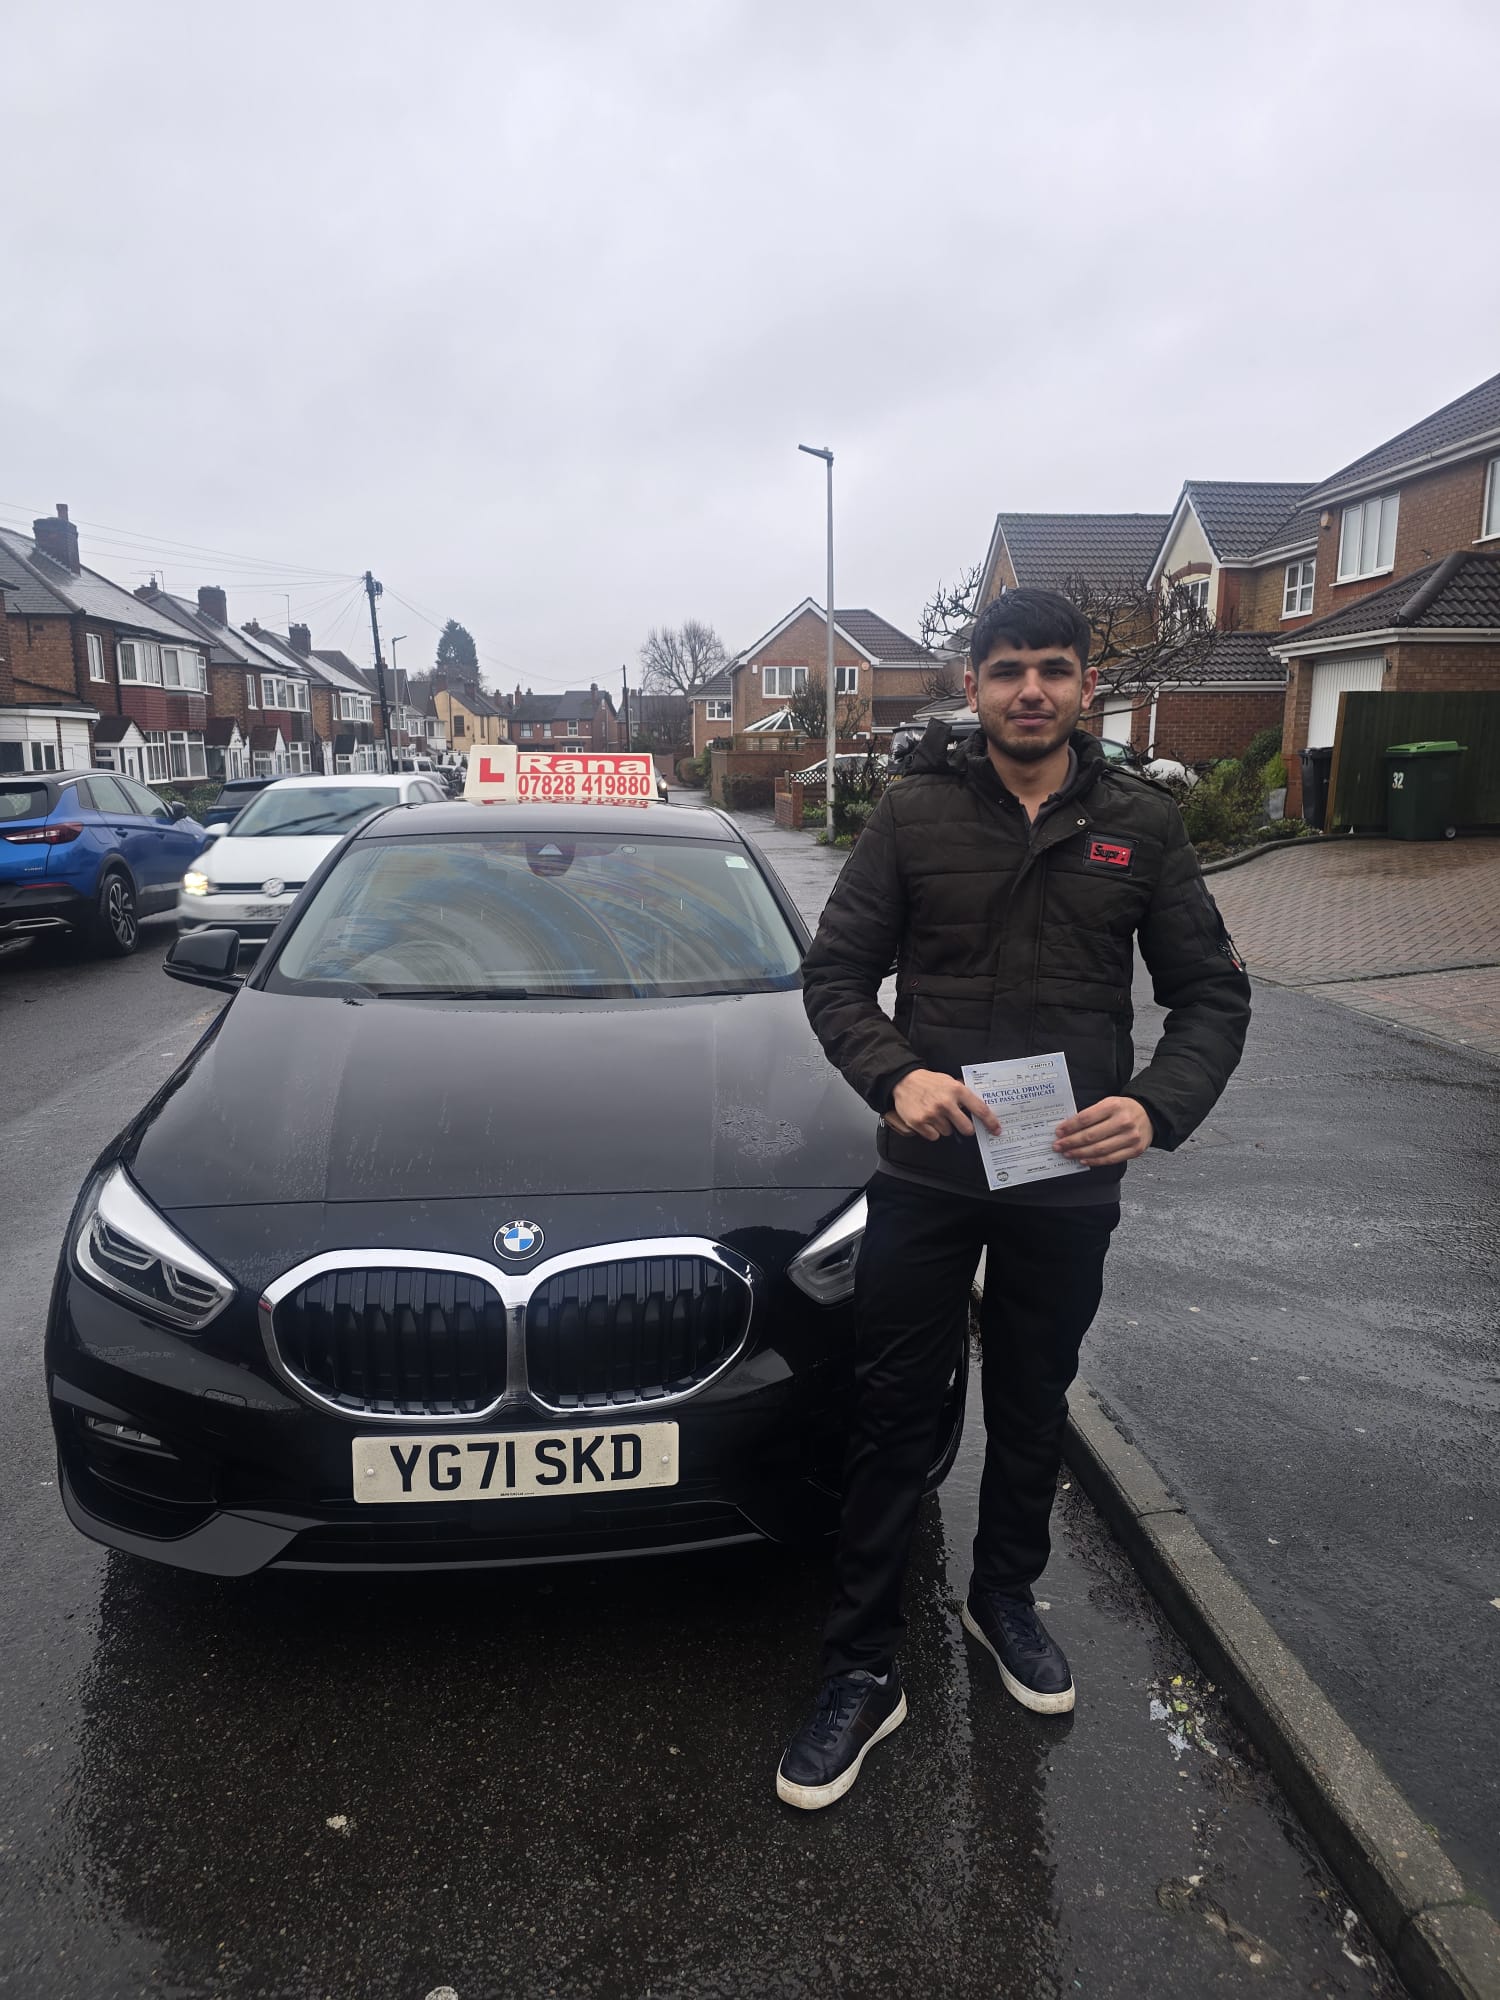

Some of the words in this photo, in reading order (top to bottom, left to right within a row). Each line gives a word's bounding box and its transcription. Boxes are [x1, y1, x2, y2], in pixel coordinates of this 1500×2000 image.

[479, 757, 505, 783] L
[519, 755, 648, 774] Rana
[518, 775, 576, 796] 07828
[581, 775, 650, 796] 419880
[1392, 771, 1404, 789] 32
[982, 1085, 1021, 1099] PRACTICAL
[1022, 1082, 1055, 1094] DRIVING
[1000, 1095, 1015, 1103] PASS
[1016, 1089, 1056, 1100] CERTIFICATE
[500, 1221, 541, 1234] BMW
[389, 1441, 516, 1492] YG71
[534, 1433, 642, 1486] SKD
